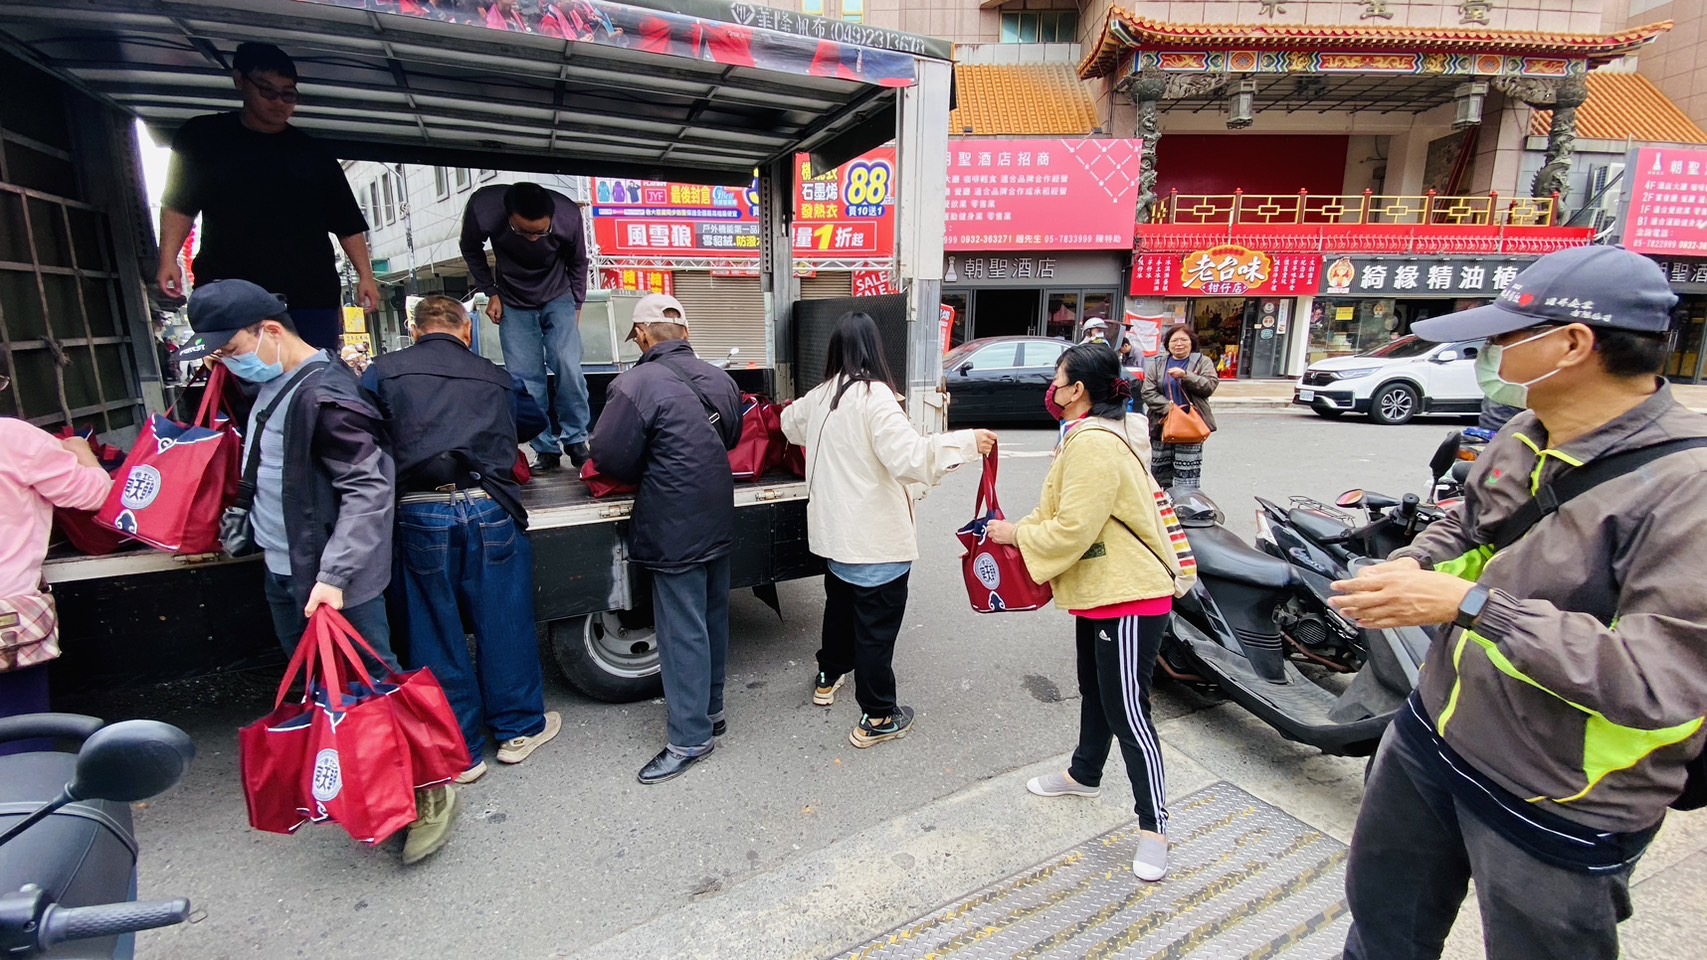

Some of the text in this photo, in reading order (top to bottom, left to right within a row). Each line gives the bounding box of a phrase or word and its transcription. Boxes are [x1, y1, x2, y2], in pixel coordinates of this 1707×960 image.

[671, 185, 710, 204] 最後封倉
[802, 182, 839, 201] 石墨烯
[847, 165, 888, 205] 88
[1645, 181, 1656, 191] 4F
[1642, 192, 1654, 203] 2F
[802, 203, 838, 219] 發熱衣
[848, 206, 882, 217] 買10送1
[628, 223, 691, 247] 風雪狼
[702, 223, 760, 234] 戶外機能第一品
[792, 224, 864, 250] 量1折起
[964, 257, 1056, 279] 朝聖酒店
[1182, 254, 1265, 288] 老台味
[856, 271, 887, 291] SALE
